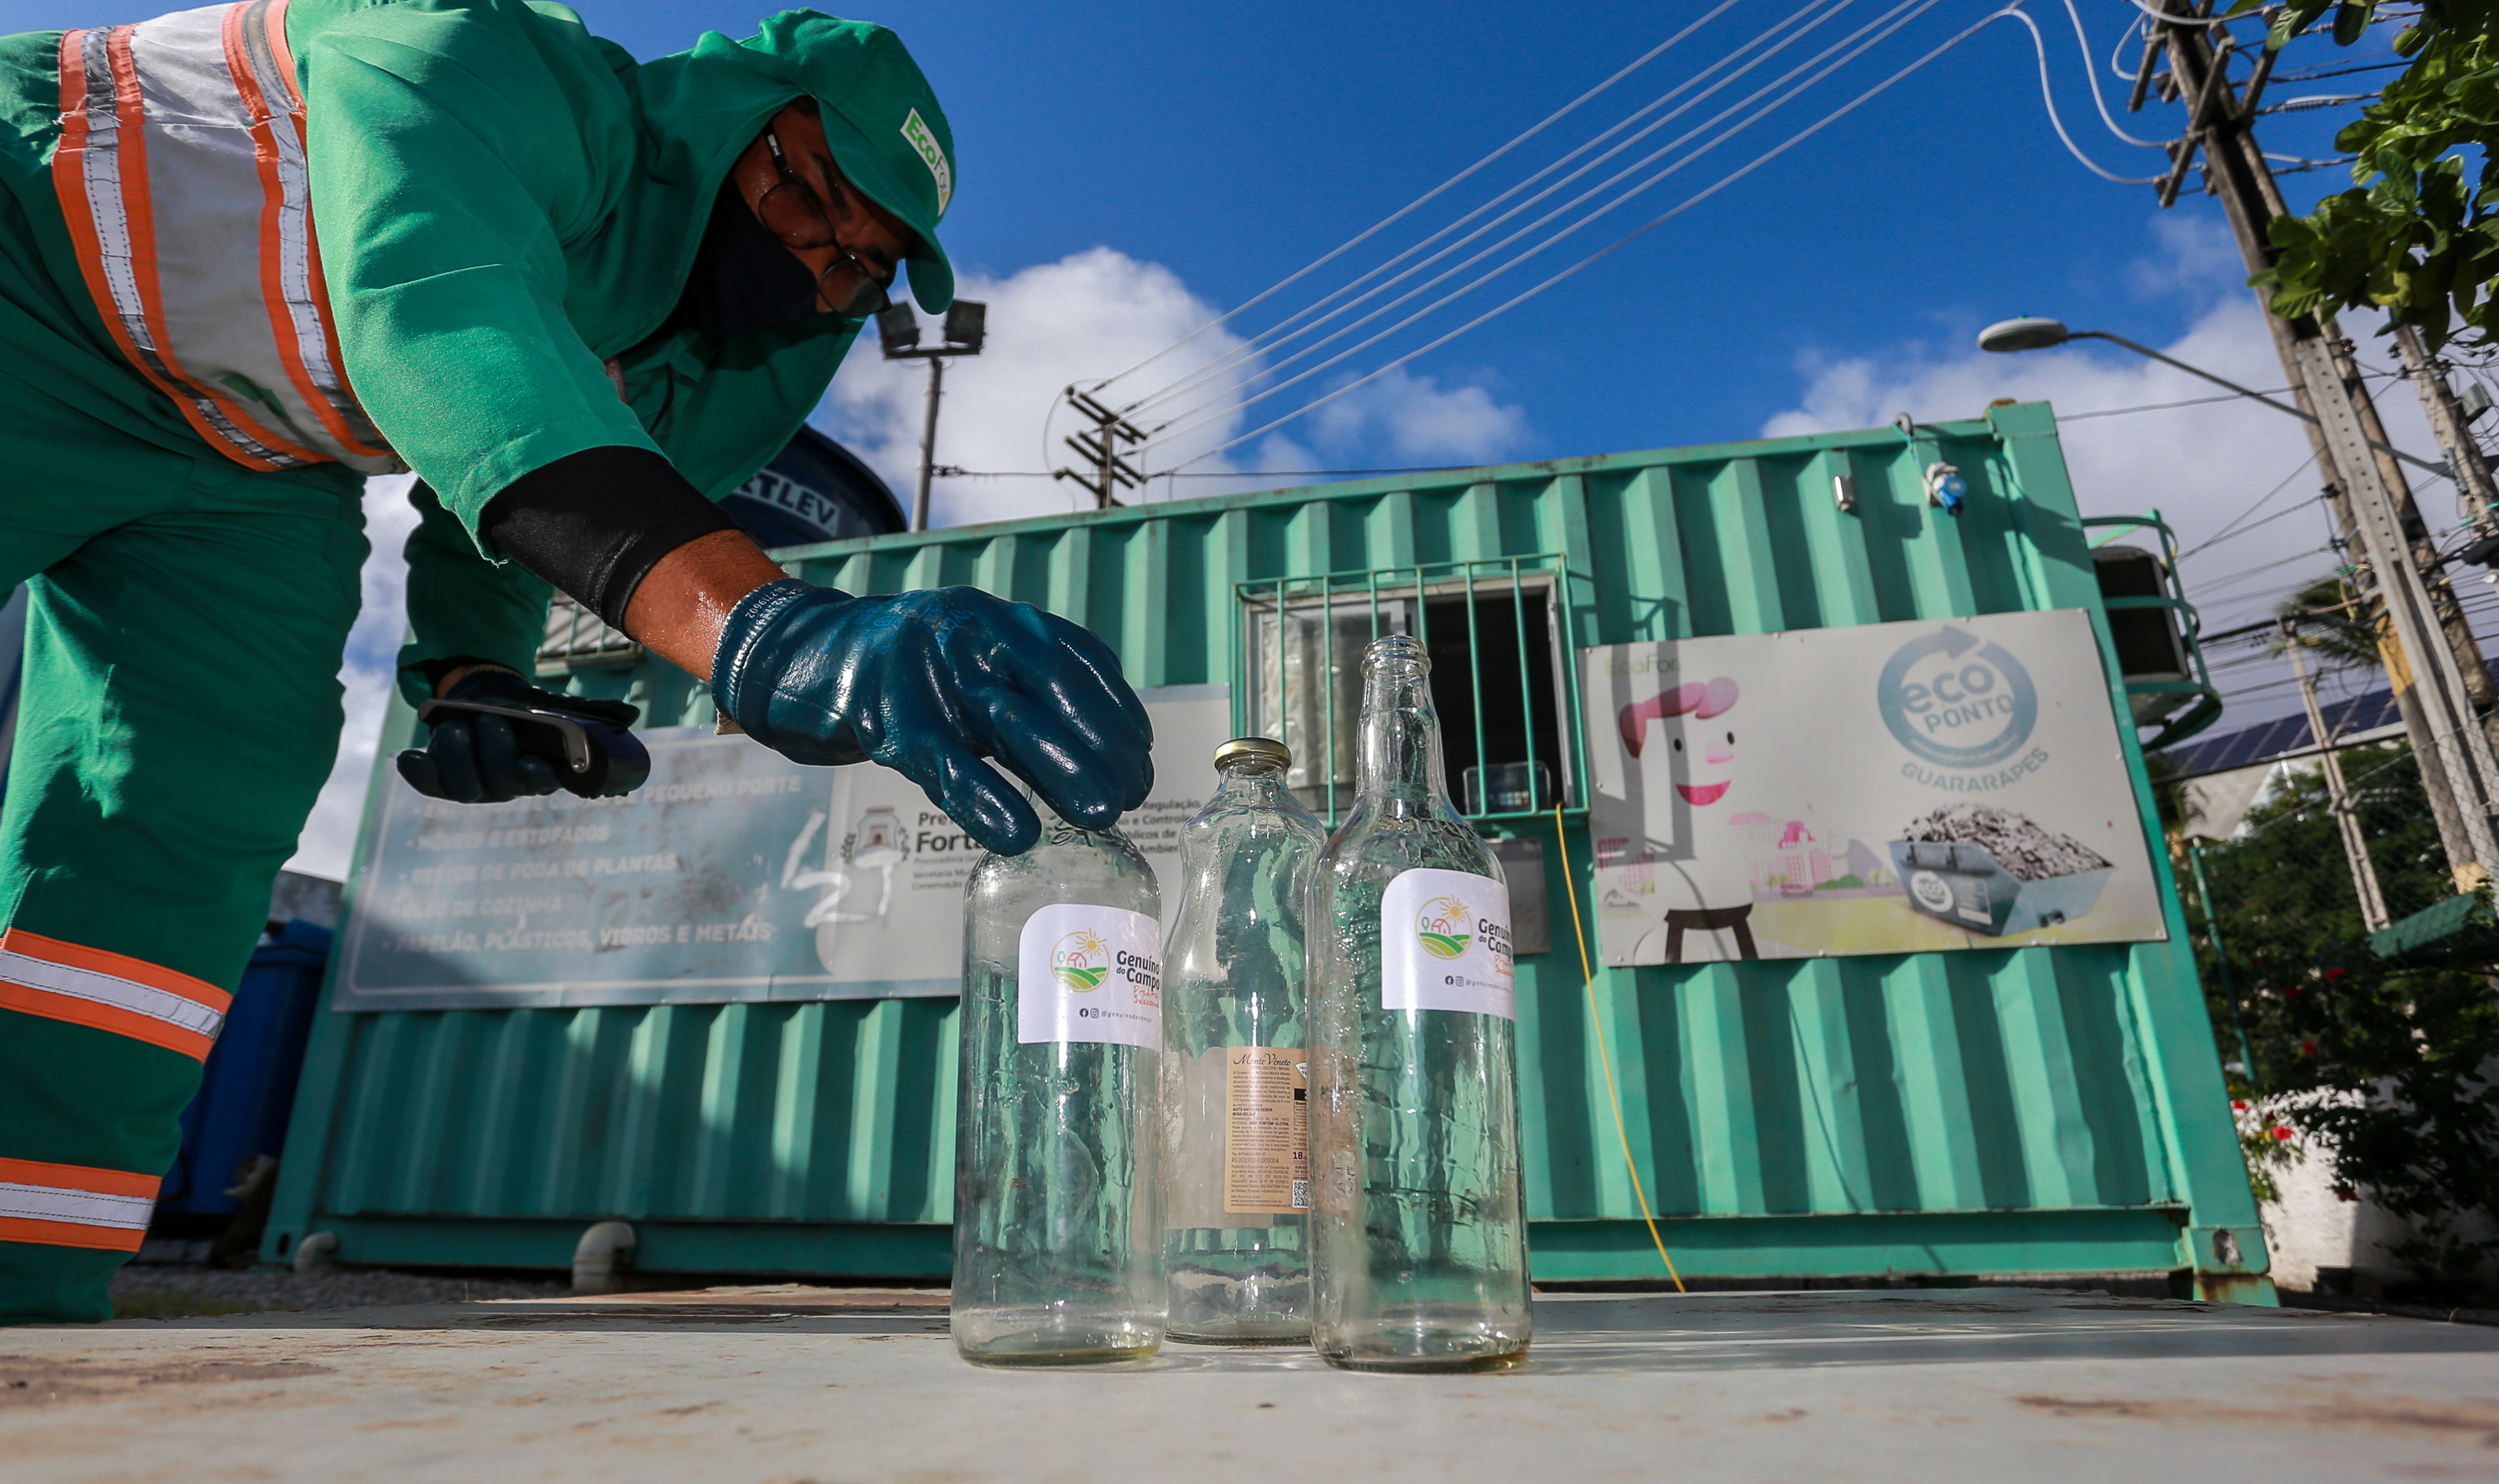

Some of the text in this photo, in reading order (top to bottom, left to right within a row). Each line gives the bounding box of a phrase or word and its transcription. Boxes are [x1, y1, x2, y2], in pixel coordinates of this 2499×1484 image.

[1900, 664, 1994, 714] eco
[1924, 695, 2015, 734] PONTO
[1902, 747, 2048, 792] GUARARAPES
[642, 780, 731, 802] PEQUENO
[737, 774, 801, 796] PORTE
[505, 824, 610, 846] ESTOFADOS
[1161, 828, 1176, 839] de
[480, 863, 501, 880] DE
[509, 861, 561, 879] PODA
[564, 859, 590, 877] DE
[594, 854, 676, 874] PLANTAS
[481, 895, 562, 915] COZINHA
[600, 925, 671, 945] VIDROS
[676, 924, 690, 943] E
[696, 922, 771, 942] METAIS
[1479, 919, 1511, 942] Genuín
[1488, 936, 1514, 963] Camp
[1117, 950, 1159, 975] Genuíno
[1126, 968, 1160, 993] Campo
[1233, 1053, 1265, 1065] Monte
[1292, 1152, 1303, 1161] 18
